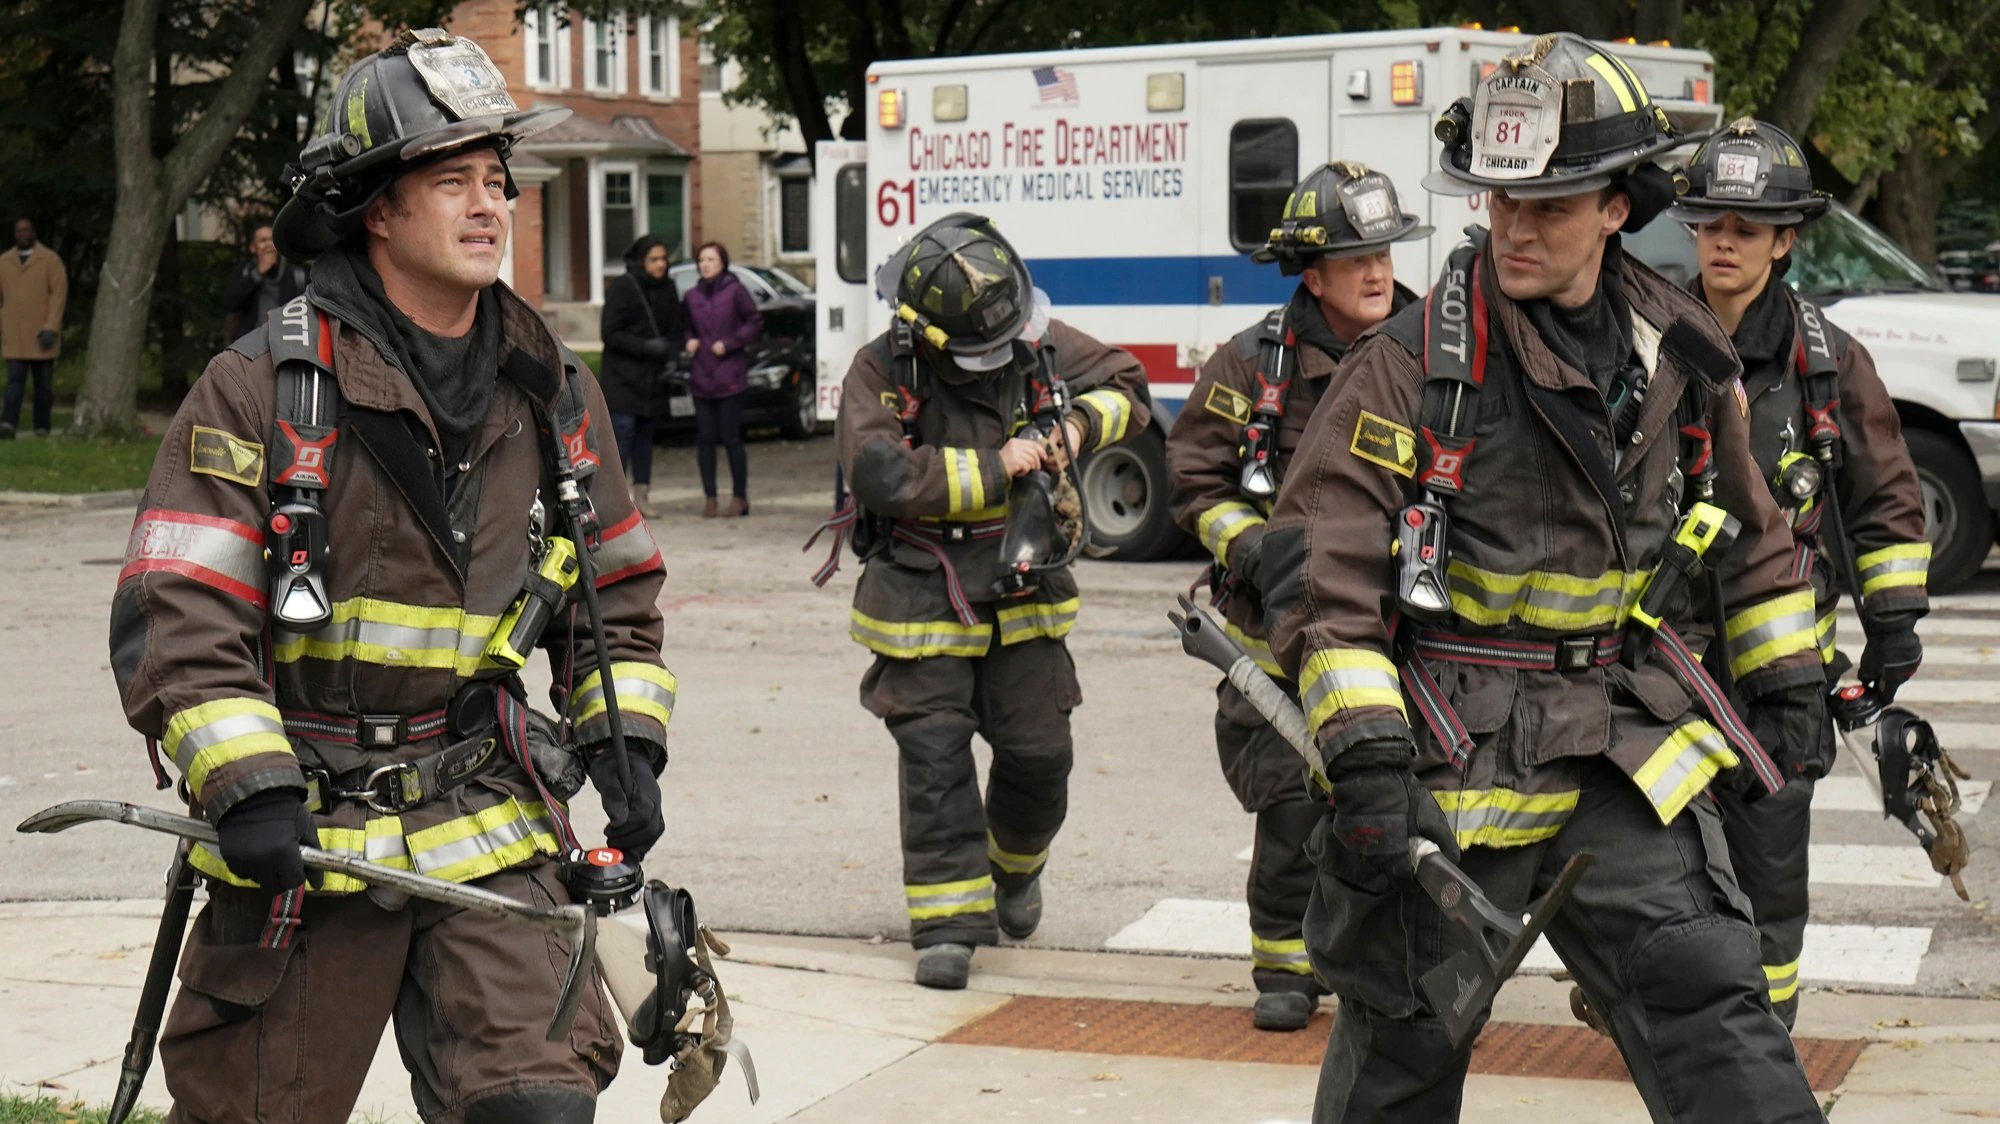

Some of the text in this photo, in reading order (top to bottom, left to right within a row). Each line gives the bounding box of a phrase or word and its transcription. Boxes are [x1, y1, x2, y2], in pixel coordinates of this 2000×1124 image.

[1495, 77, 1540, 94] CAPTAIN
[465, 95, 509, 110] CHICAGO
[1500, 109, 1526, 118] TRUCK
[1495, 121, 1522, 145] 81
[909, 118, 1190, 171] CHICAGO FIRE DEPARTMENT
[1485, 157, 1528, 169] CHICAGO
[1727, 163, 1746, 177] 81
[918, 169, 1183, 205] EMERGENCY MEDICAL SERVICES
[877, 179, 916, 227] 61
[1366, 201, 1385, 216] 81
[1440, 268, 1467, 364] SCOTT
[1795, 297, 1830, 358] COTT
[295, 472, 319, 481] AIR-PAK
